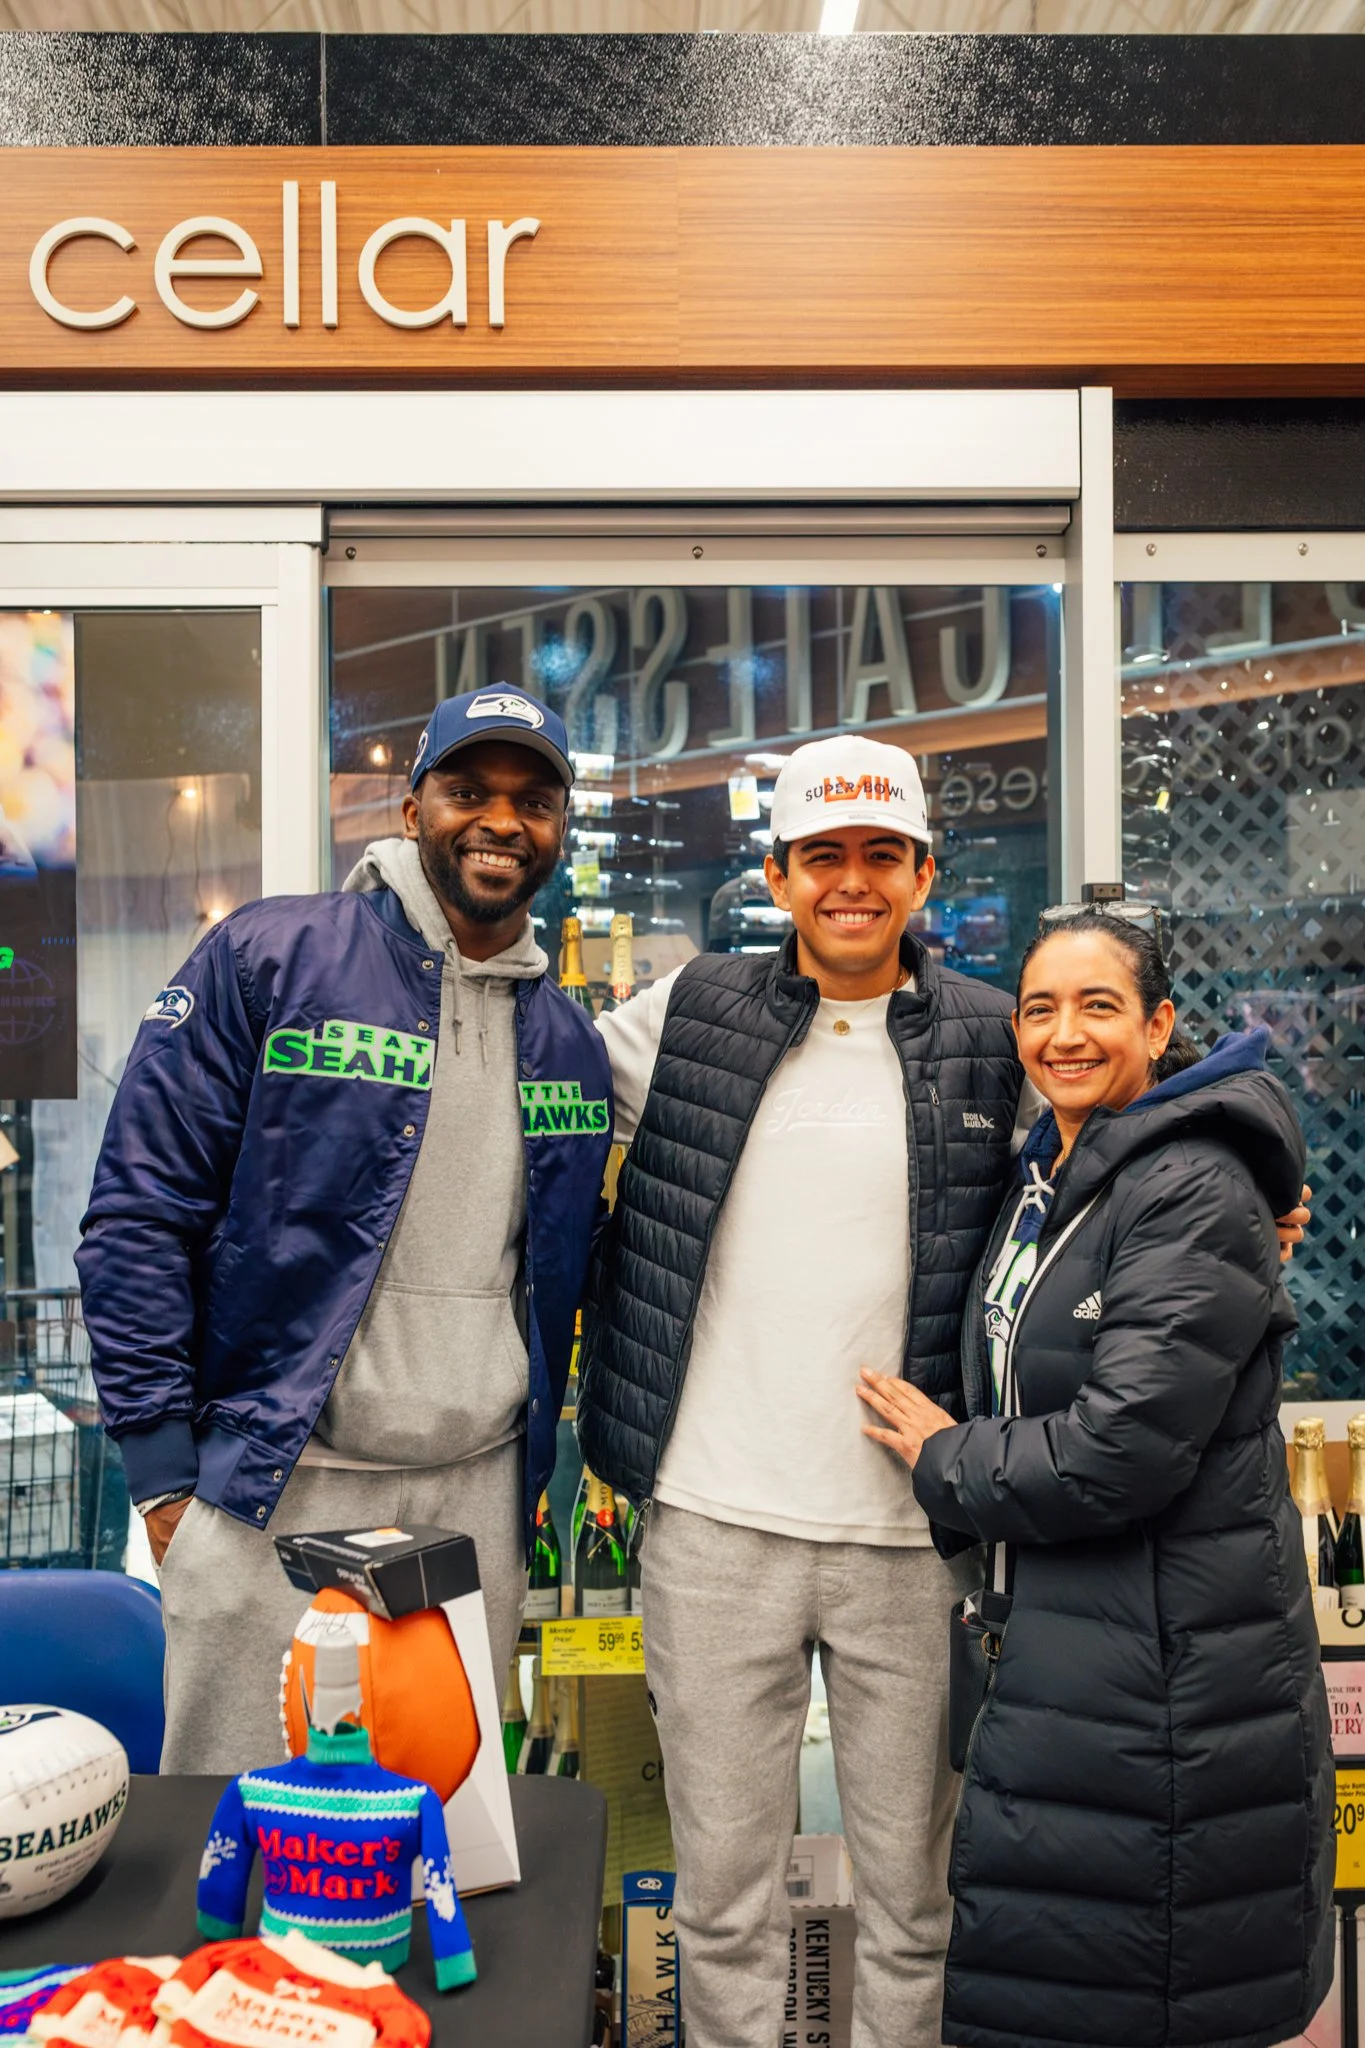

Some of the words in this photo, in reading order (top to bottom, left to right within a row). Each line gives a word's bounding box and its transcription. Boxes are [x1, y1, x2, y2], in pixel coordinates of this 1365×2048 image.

[29, 180, 541, 330] cellar
[805, 781, 855, 803] SUPER
[863, 780, 907, 801] BOWL
[327, 1025, 428, 1054] SEAT
[523, 1086, 580, 1100] TTLE
[765, 1084, 892, 1134] Jordan
[1073, 1306, 1102, 1321] adid
[1332, 1702, 1349, 1716] TO
[1354, 1701, 1362, 1715] A
[1331, 1718, 1364, 1735] ERY
[257, 1826, 402, 1868] Maker's
[289, 1867, 400, 1901] Mark
[805, 1919, 830, 2024] KENTUCKY
